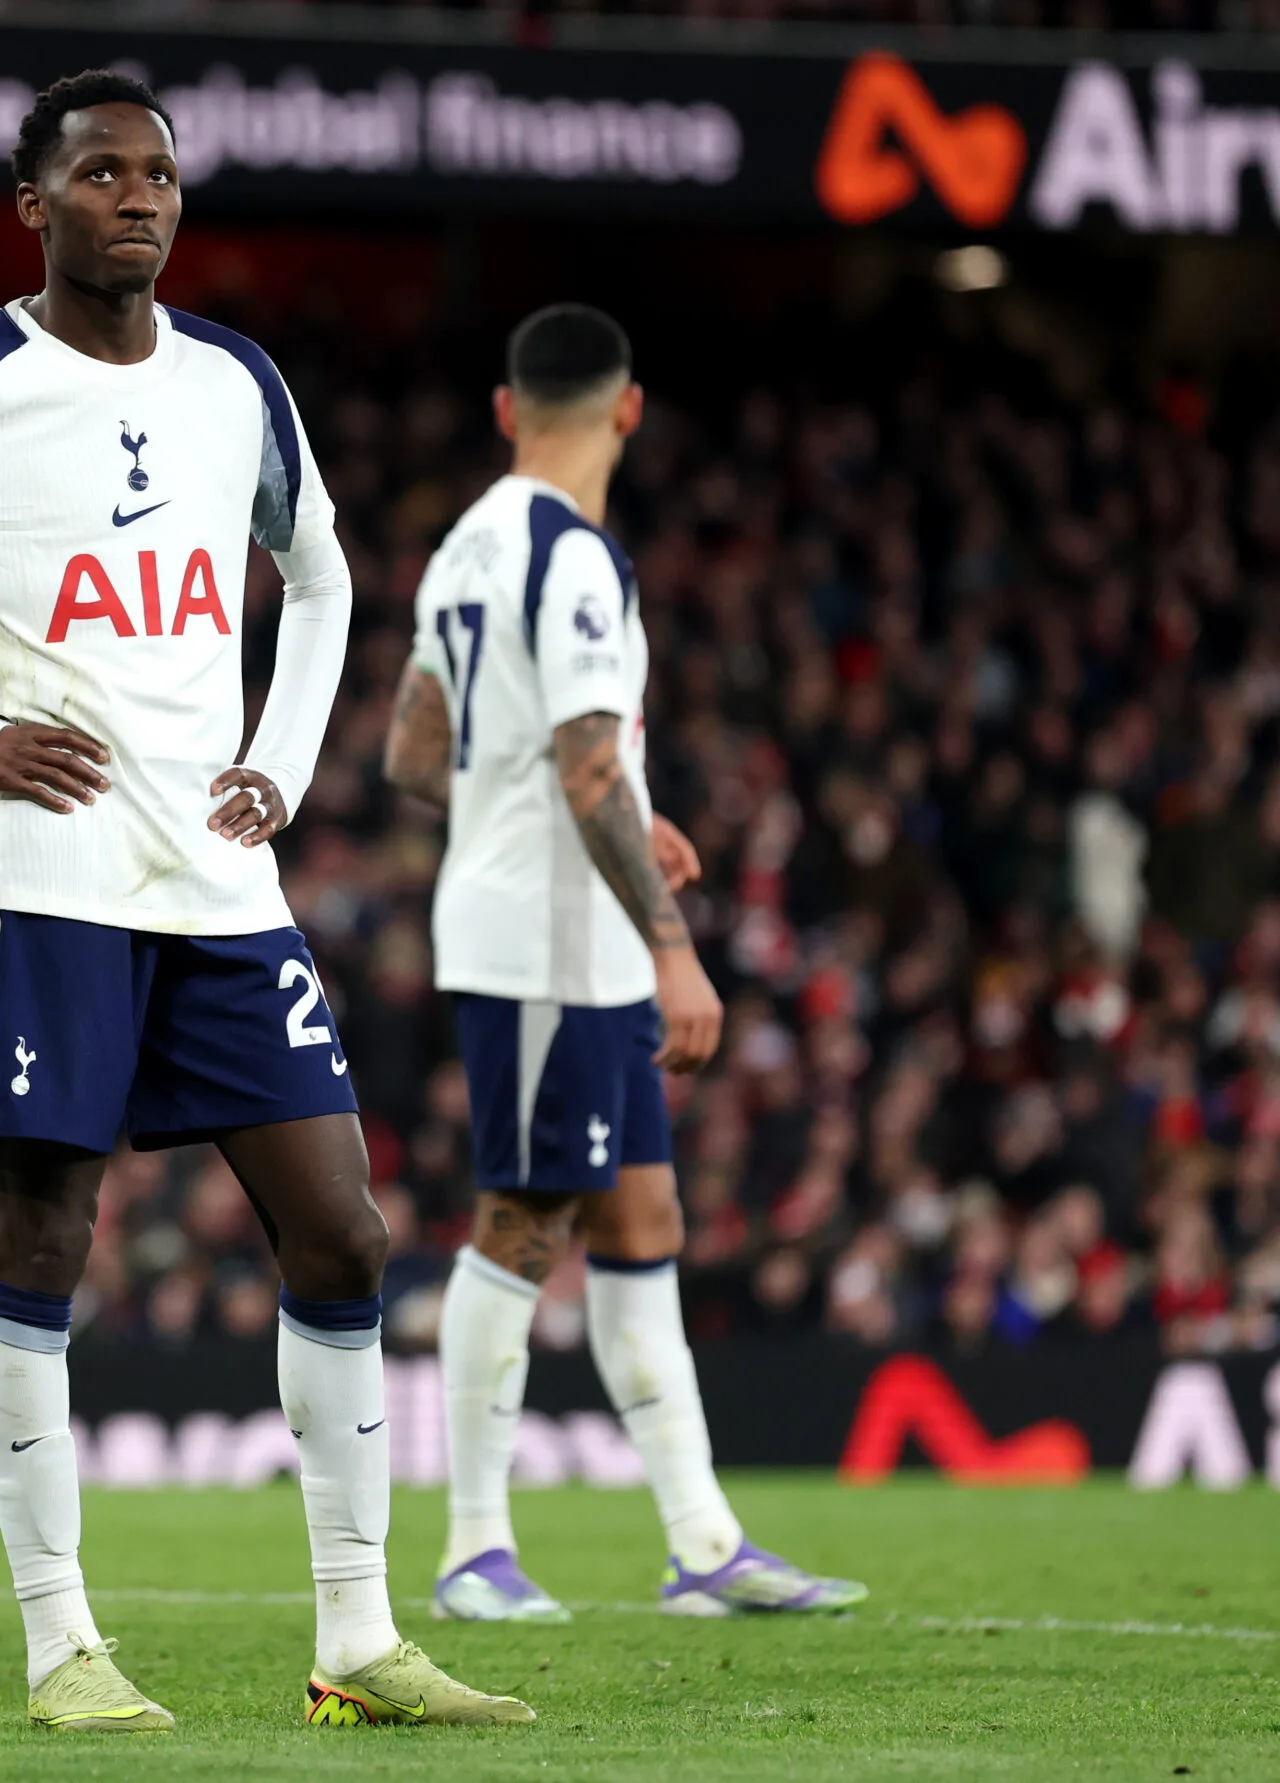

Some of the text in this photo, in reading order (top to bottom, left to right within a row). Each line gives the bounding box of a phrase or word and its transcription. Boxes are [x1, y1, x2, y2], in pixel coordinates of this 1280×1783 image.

[427, 70, 742, 185] finance
[1032, 58, 1280, 234] Air
[45, 548, 232, 643] AIA
[435, 603, 484, 771] 17
[278, 959, 332, 1048] 2
